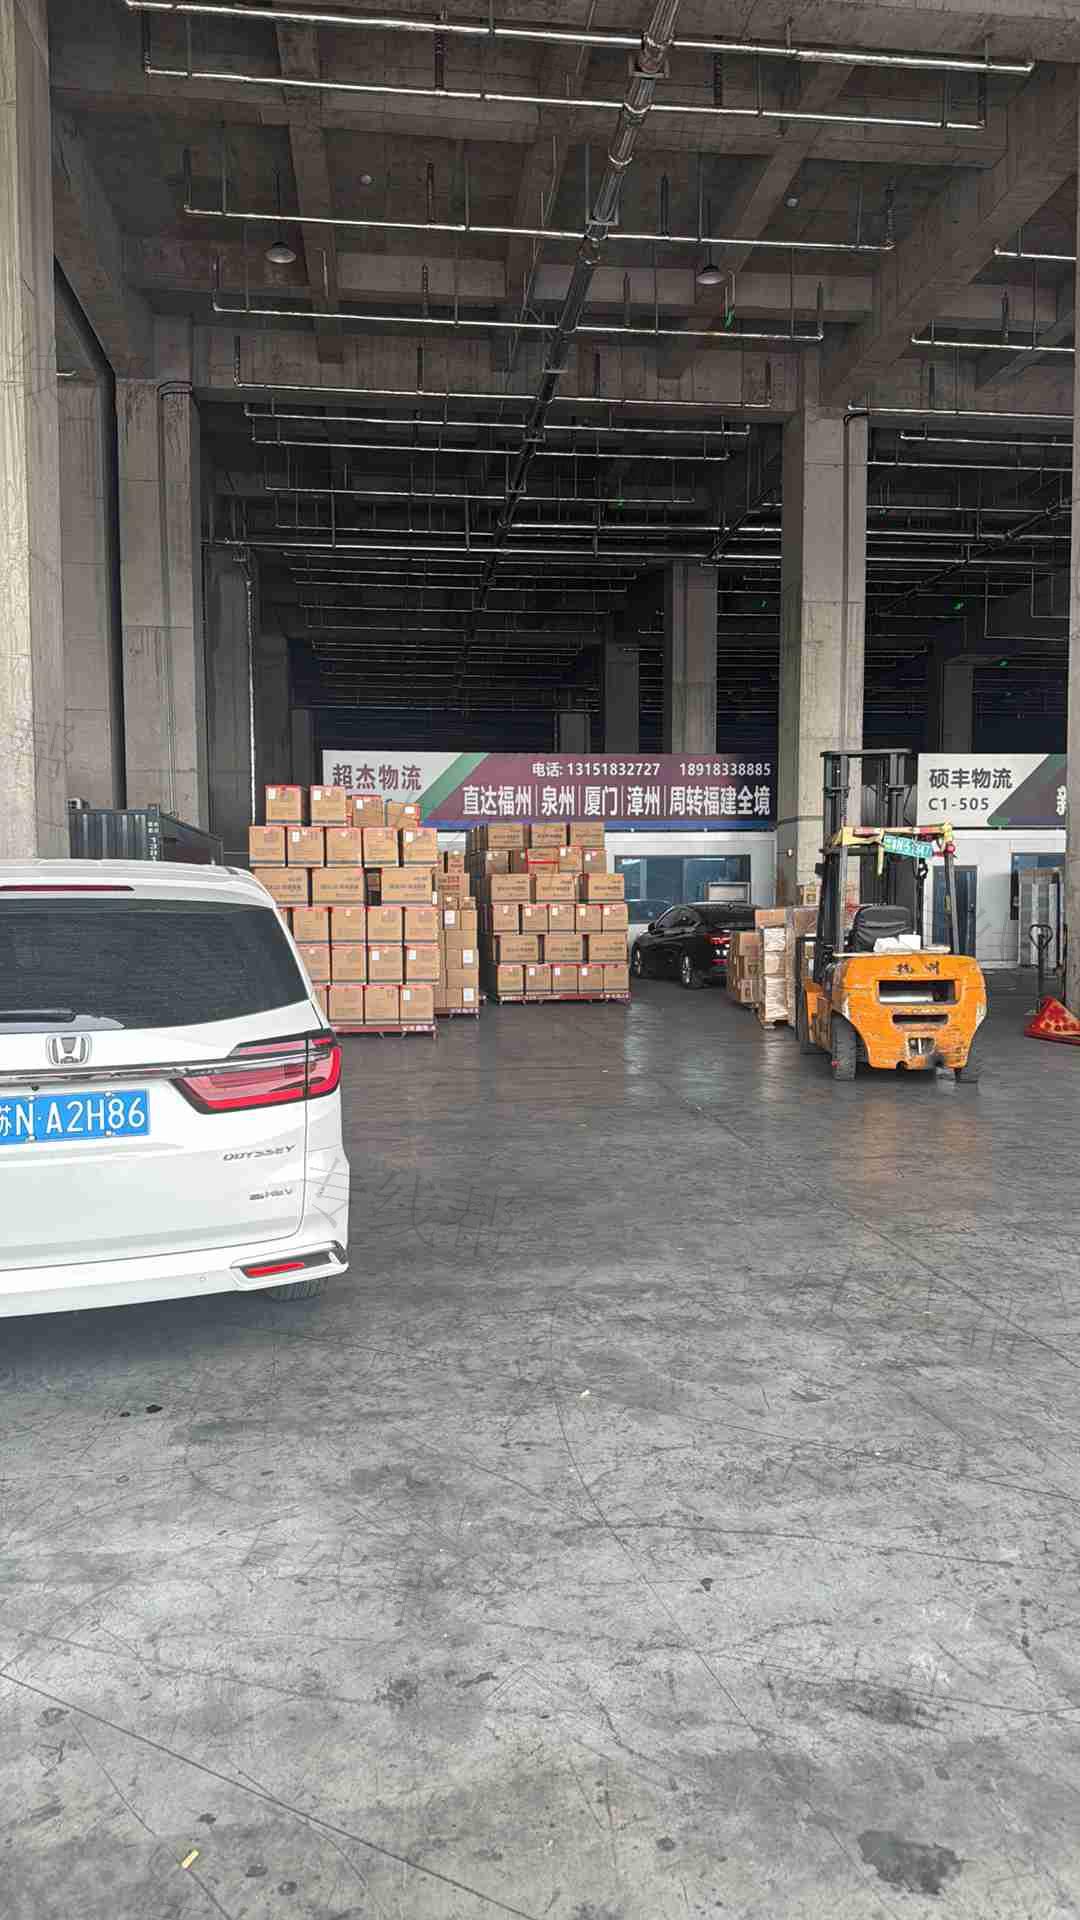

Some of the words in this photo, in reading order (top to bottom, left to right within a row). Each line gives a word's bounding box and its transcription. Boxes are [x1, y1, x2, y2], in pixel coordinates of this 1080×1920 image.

[331, 763, 422, 791] 超杰物流
[567, 762, 660, 777] 13151832727
[680, 763, 771, 776] 18918338885
[928, 767, 1013, 789] 硕丰物流
[462, 784, 532, 816] 直达福州
[541, 785, 575, 816] 泉州
[584, 786, 618, 816] 厦门
[627, 786, 660, 816] 漳州
[669, 786, 771, 816] 周转福建全境
[928, 797, 989, 811] C1-505
